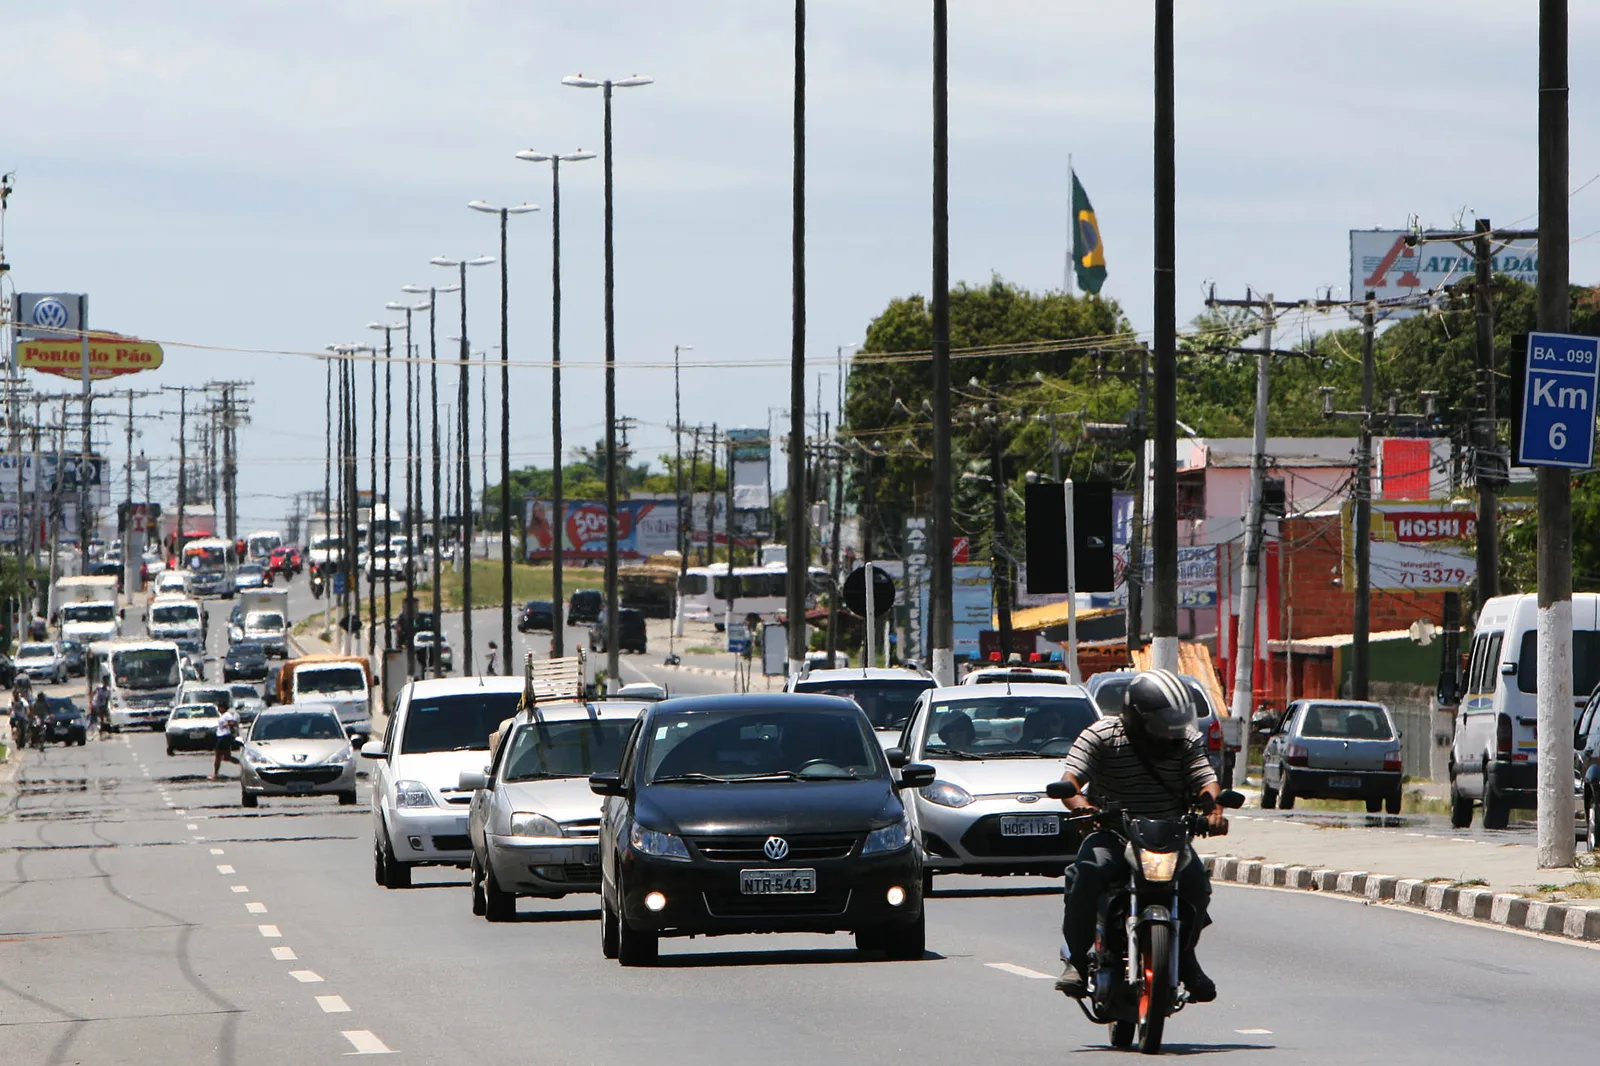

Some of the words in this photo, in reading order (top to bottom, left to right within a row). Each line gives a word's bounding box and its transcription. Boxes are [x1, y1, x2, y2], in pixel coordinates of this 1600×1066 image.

[24, 347, 81, 363] Ponto
[115, 347, 152, 363] Pão
[1532, 377, 1588, 410] Km
[1548, 422, 1567, 450] 6
[1398, 519, 1460, 537] HOSHI
[744, 878, 812, 893] NTR-5443
